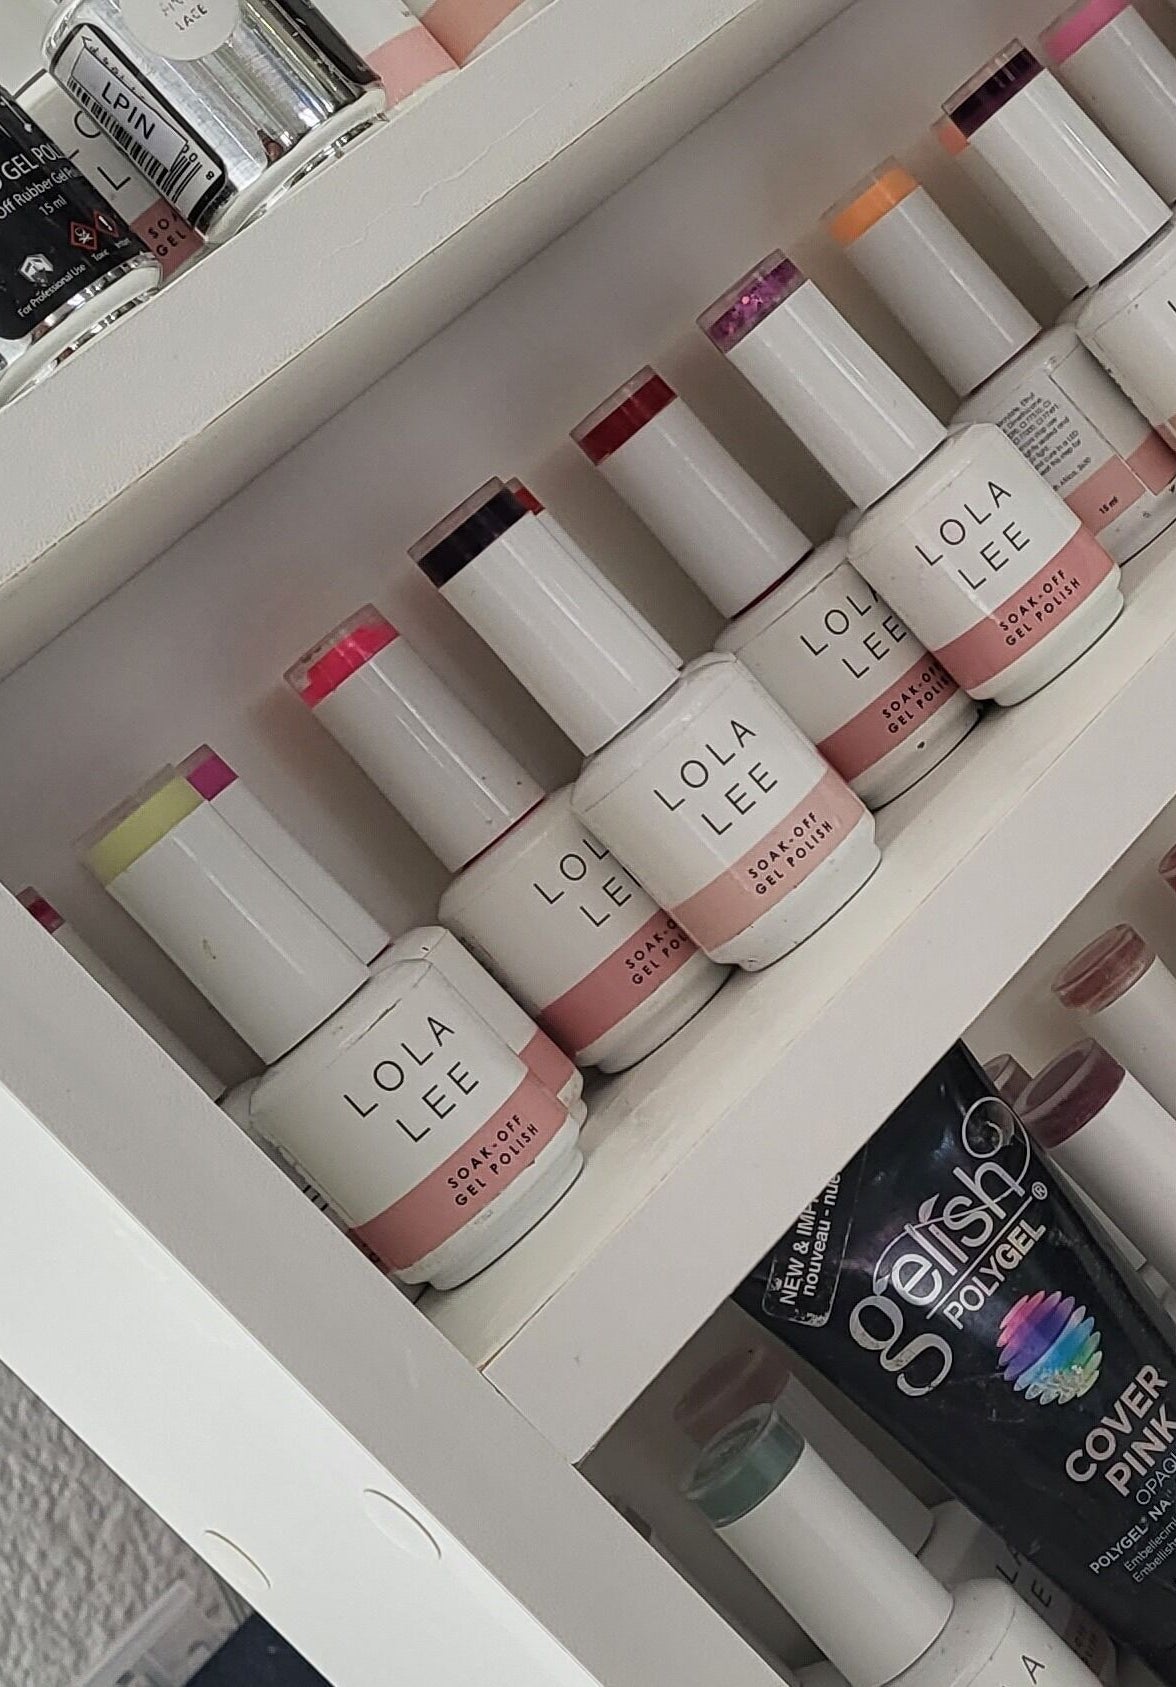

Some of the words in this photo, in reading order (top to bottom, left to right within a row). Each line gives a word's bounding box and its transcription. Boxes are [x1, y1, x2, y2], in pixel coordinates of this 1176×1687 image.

[2, 149, 40, 180] GEL
[12, 179, 52, 208] Rubber
[39, 203, 54, 216] 15
[53, 195, 68, 211] ml
[30, 271, 74, 308] Professional
[68, 264, 87, 279] Use
[915, 480, 1012, 566] LOLA
[957, 521, 1031, 590] LEE
[1000, 568, 1067, 631] SOAK-OFF
[1005, 623, 1031, 647] GEL
[1035, 577, 1082, 623] POLISH
[842, 615, 907, 679] LEE
[888, 710, 915, 734] GEL
[653, 719, 757, 812] LOLA
[701, 762, 778, 836] LEE
[748, 811, 818, 879] SOAK-OFF
[755, 869, 785, 895] GEL
[786, 820, 834, 868] POLISH
[631, 959, 661, 985] GEL
[343, 1016, 455, 1118] LOLA
[396, 1061, 479, 1143] LEE
[447, 1113, 523, 1190] SOAK-OFF
[454, 1177, 486, 1207] GEL
[488, 1123, 540, 1175] POLISH
[778, 1256, 805, 1306] NEW
[802, 1219, 832, 1297] nouveau
[850, 1096, 1030, 1397] gelish
[943, 1219, 1046, 1330] POLYGEL
[1065, 1364, 1168, 1482] COVER
[1148, 1489, 1174, 1521] NA
